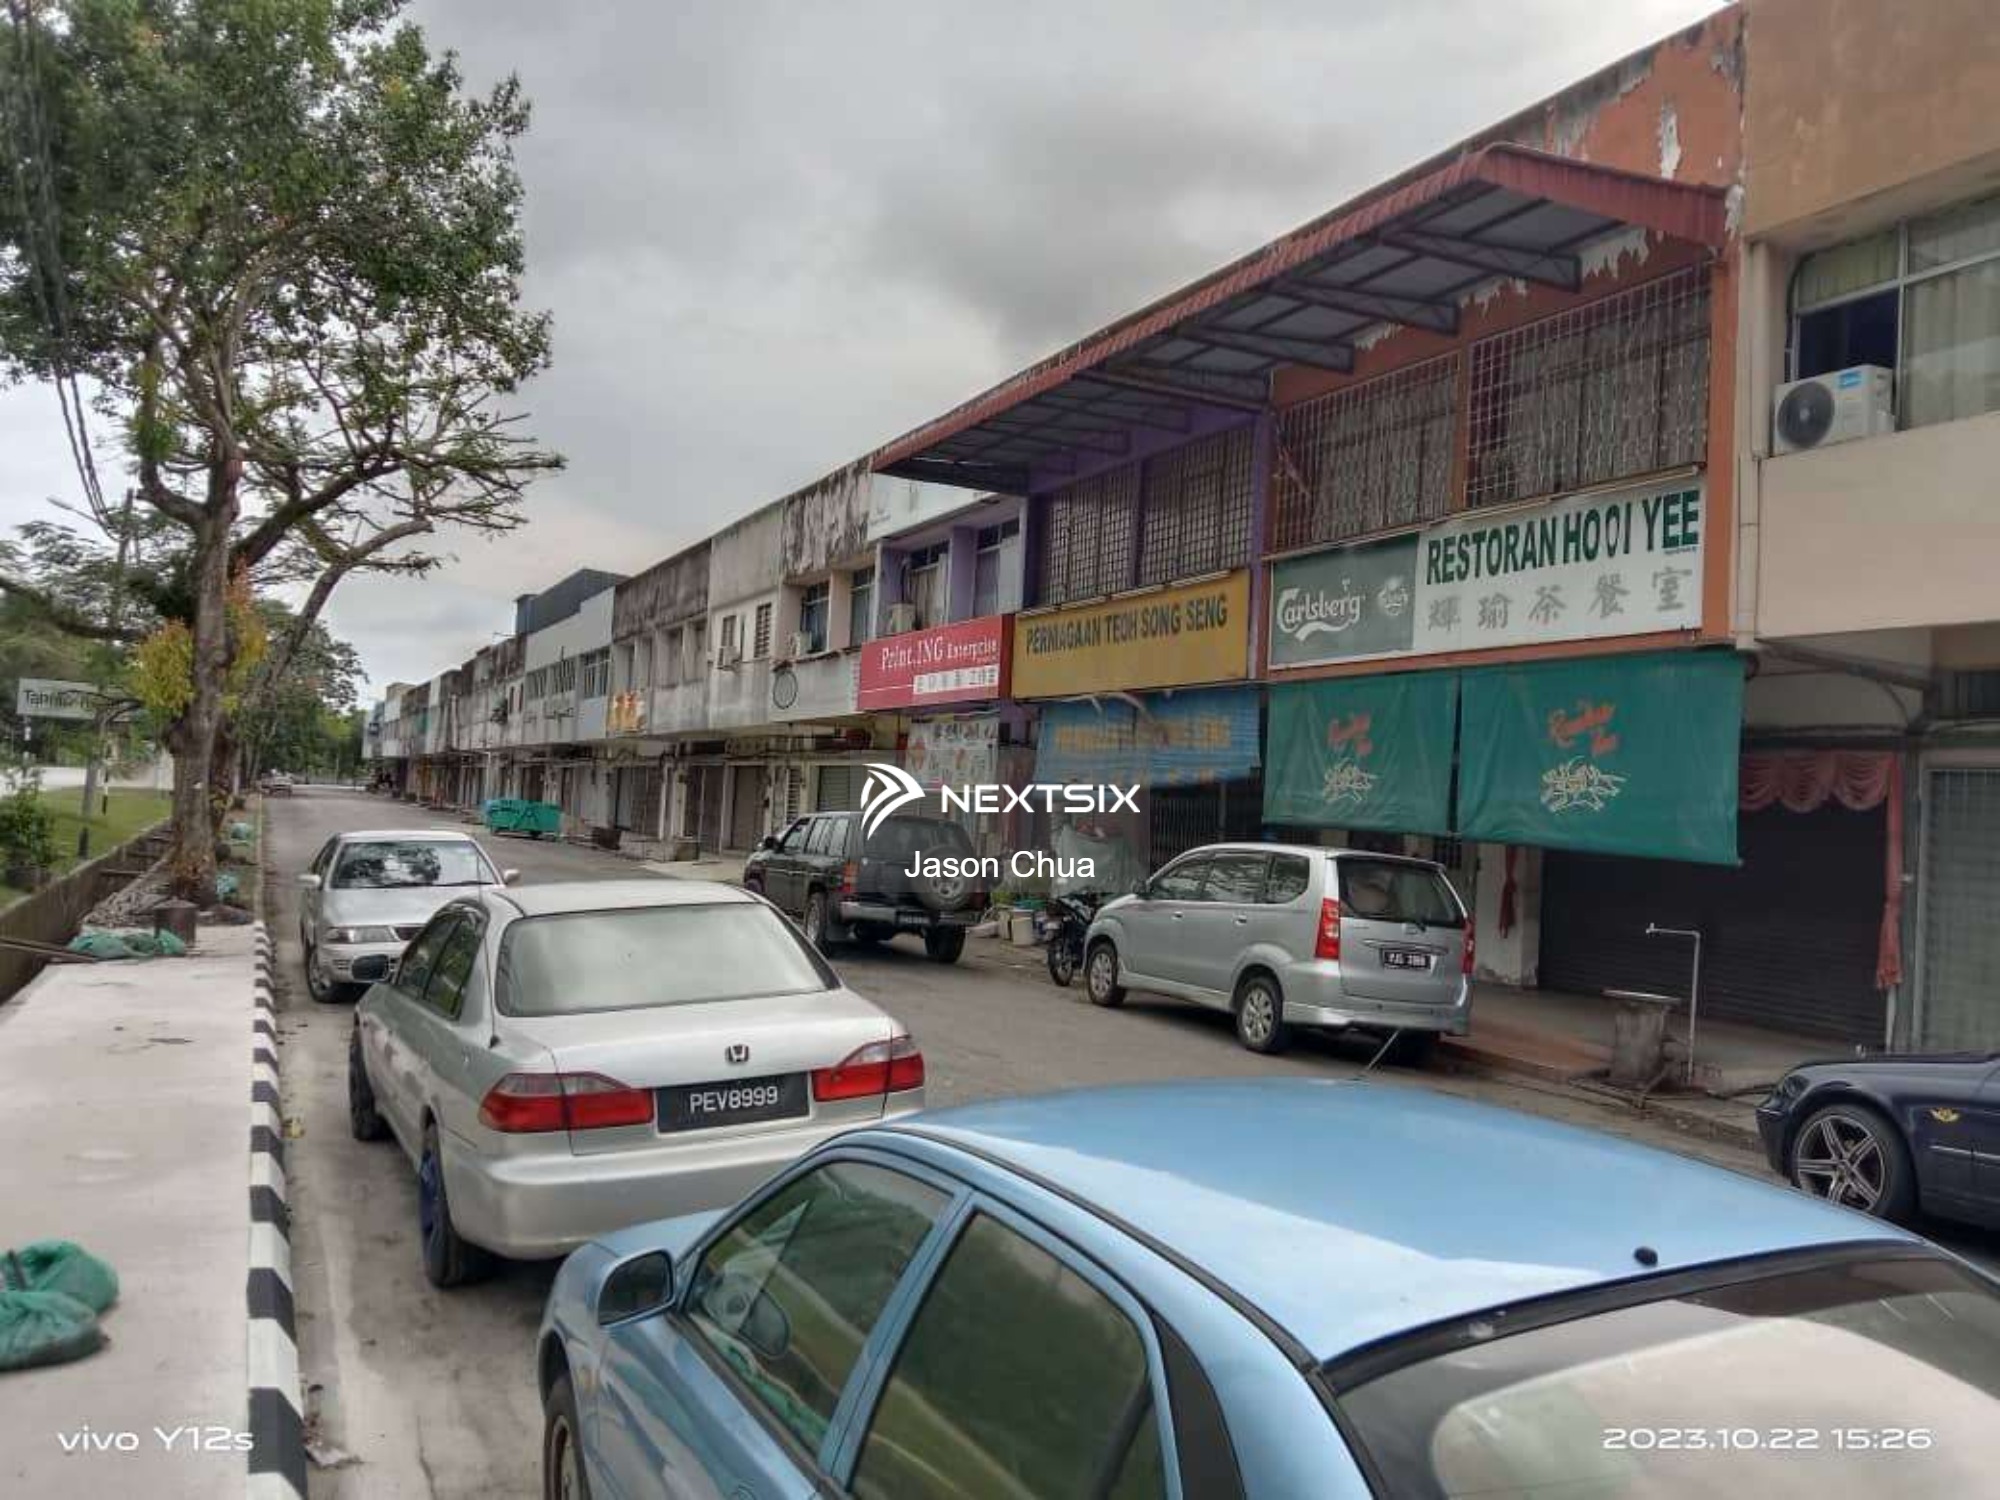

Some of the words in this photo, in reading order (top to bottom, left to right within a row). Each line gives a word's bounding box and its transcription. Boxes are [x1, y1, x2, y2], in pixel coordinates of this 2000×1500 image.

[1426, 515, 1556, 585] RESTORAN
[1563, 502, 1632, 564] HOOI
[1642, 490, 1699, 551] YEE
[1142, 603, 1181, 638] SONG
[1186, 594, 1228, 631] SENG
[1277, 588, 1360, 640] Carlsberg
[690, 1086, 778, 1113] PEV8999
